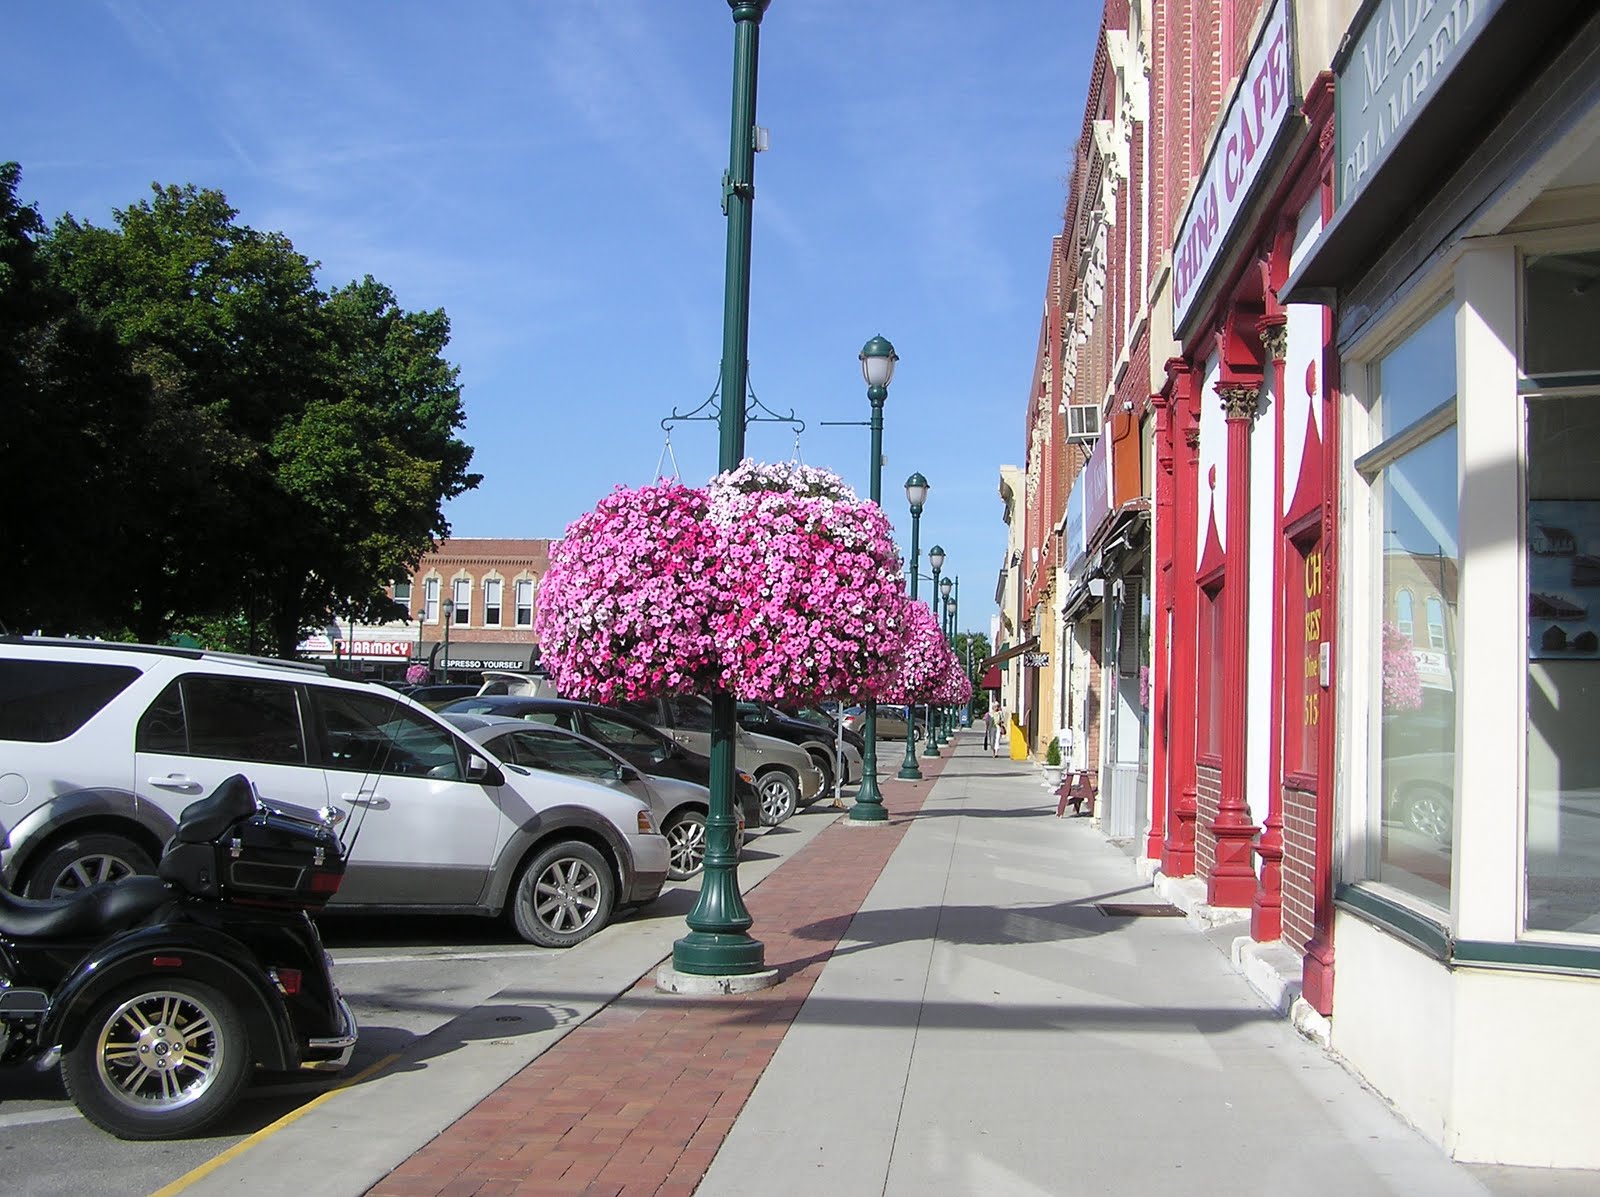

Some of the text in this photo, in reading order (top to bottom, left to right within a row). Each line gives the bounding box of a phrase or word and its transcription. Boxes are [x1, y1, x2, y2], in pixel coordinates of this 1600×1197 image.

[1361, 0, 1437, 114] MAD
[1173, 23, 1286, 309] CHINA CAFE
[340, 641, 409, 655] PHARMACY
[440, 659, 523, 670] ESPRESSO YOURSELF
